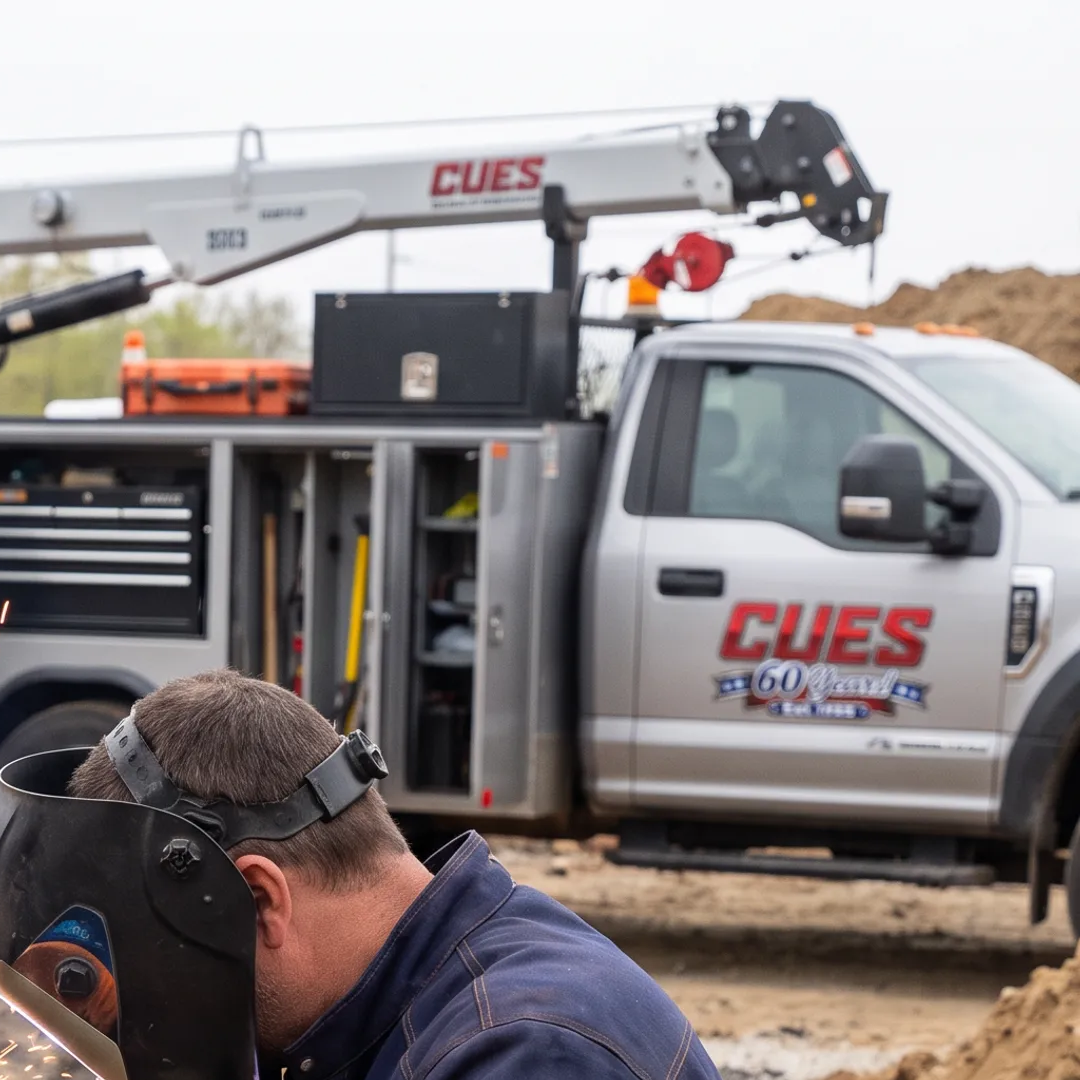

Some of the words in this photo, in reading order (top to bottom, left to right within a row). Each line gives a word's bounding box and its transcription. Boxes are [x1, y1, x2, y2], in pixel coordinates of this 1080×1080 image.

[430, 155, 546, 197] CUES
[720, 602, 933, 667] CUES
[754, 661, 806, 696] 60
